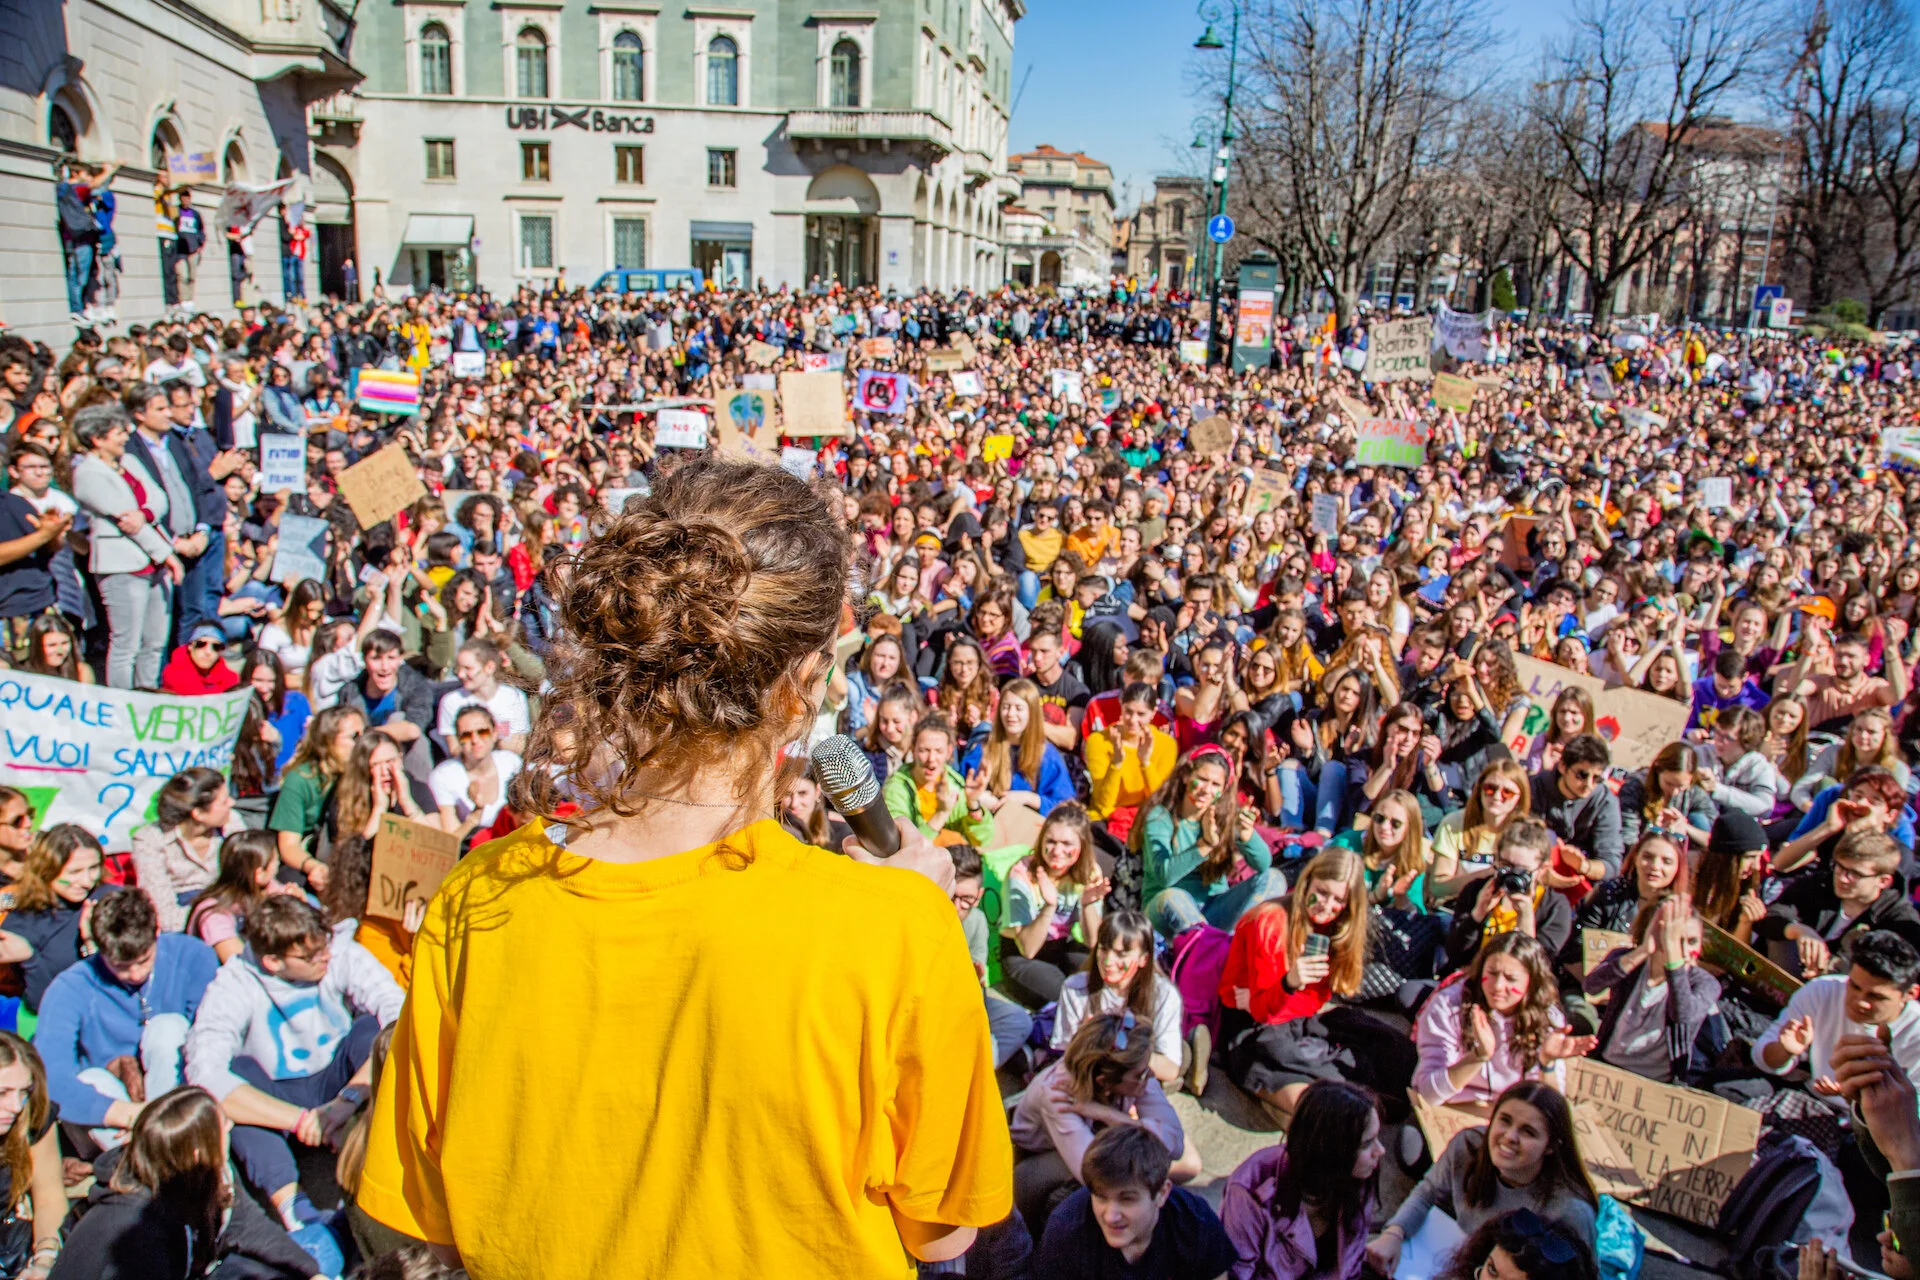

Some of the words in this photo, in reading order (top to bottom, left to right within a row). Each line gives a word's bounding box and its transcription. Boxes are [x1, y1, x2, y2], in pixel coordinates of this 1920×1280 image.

[506, 106, 546, 130] UBI
[593, 110, 654, 134] Banca
[1358, 438, 1425, 465] FUTURE
[1529, 674, 1562, 698] LA
[0, 680, 113, 728] QUALE
[126, 697, 244, 743] VERDE
[5, 729, 90, 768] VUOI
[111, 738, 235, 780] SALVARE
[97, 782, 135, 846] ?
[1633, 1086, 1646, 1111] IL
[1664, 1093, 1706, 1129] TUO
[1682, 1131, 1708, 1160] IN
[1646, 1149, 1670, 1182] LA
[1685, 1159, 1735, 1200] TERRA
